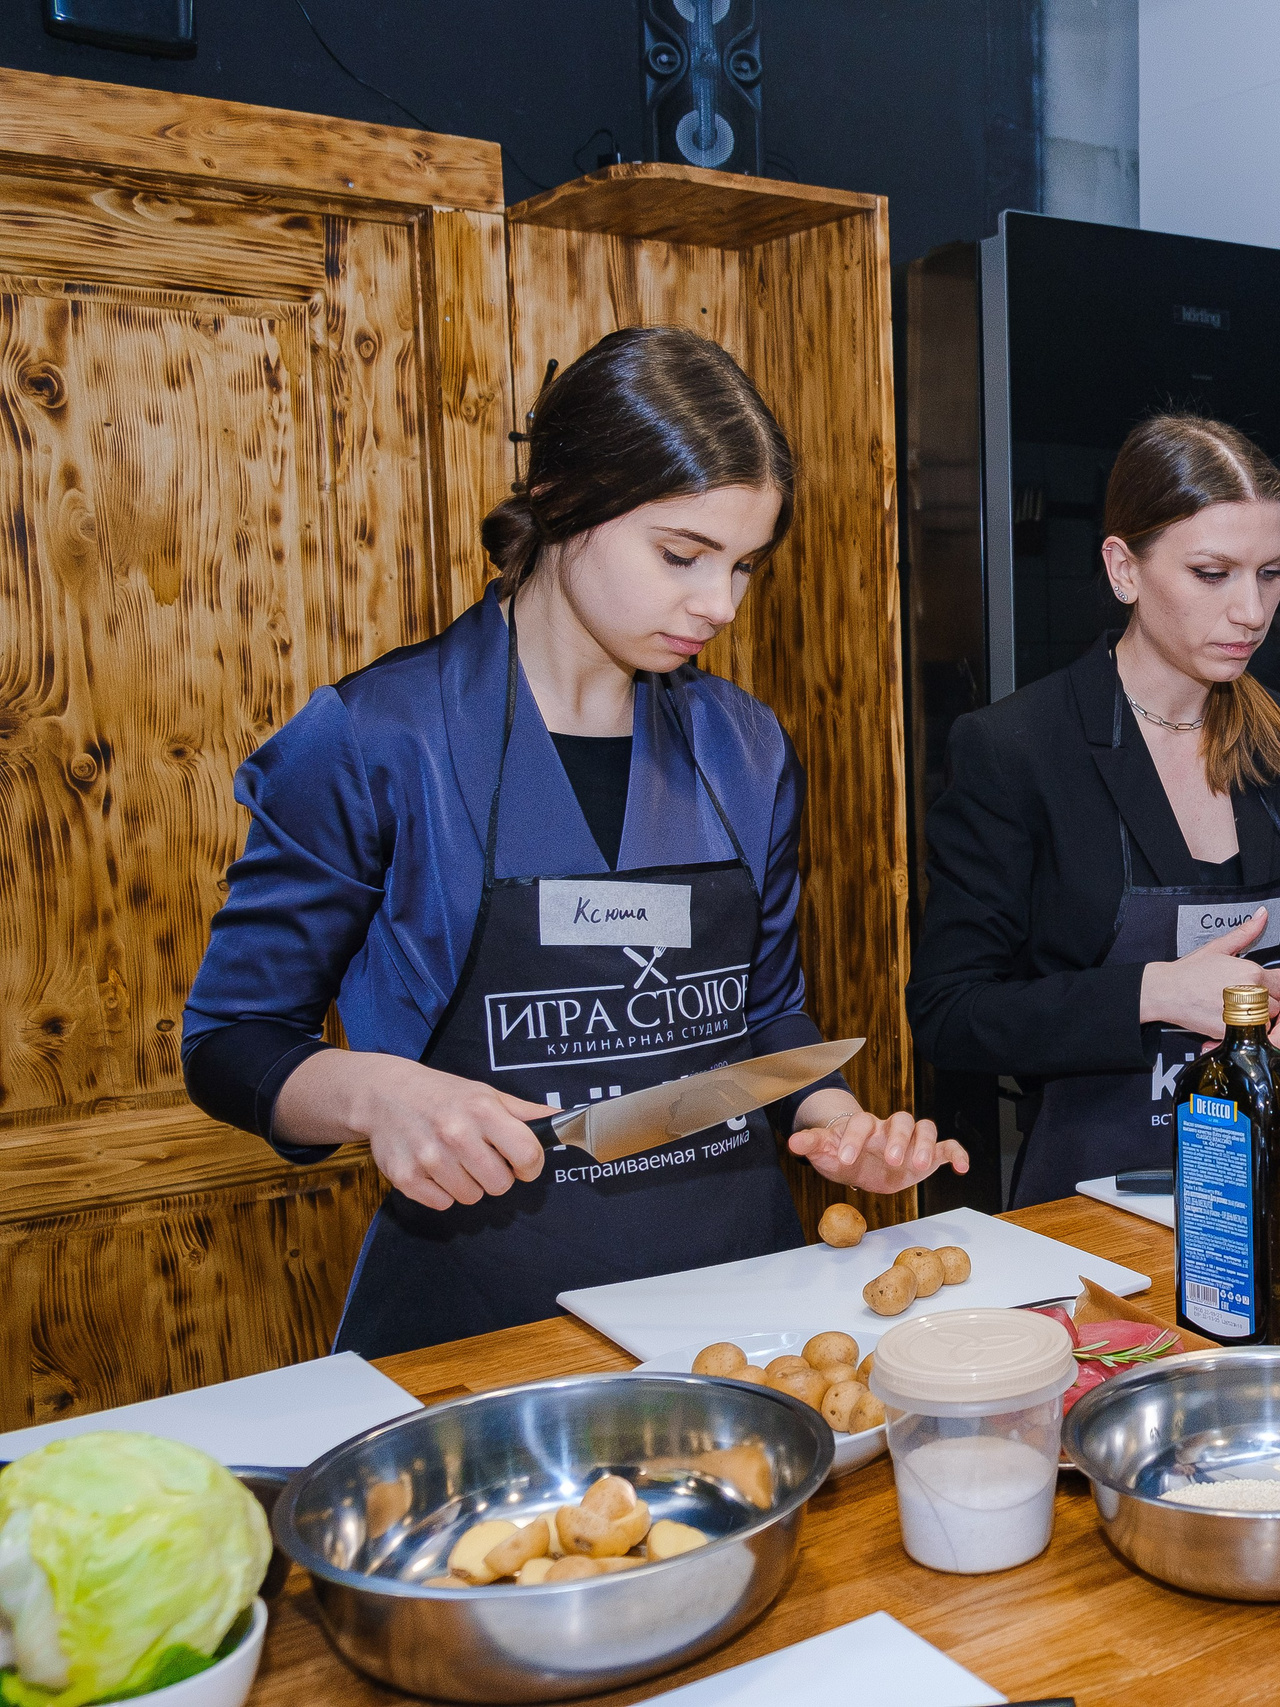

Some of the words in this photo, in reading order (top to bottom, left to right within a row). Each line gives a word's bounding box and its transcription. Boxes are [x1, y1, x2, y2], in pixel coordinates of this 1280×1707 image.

[573, 896, 649, 924] Ксюша
[498, 998, 618, 1041] ИГРА
[547, 1030, 675, 1055] КУЛИНАРНАЯ
[682, 1019, 729, 1039] СТУДИЯ
[555, 1148, 696, 1183] встраиваемая
[702, 1129, 750, 1159] техника
